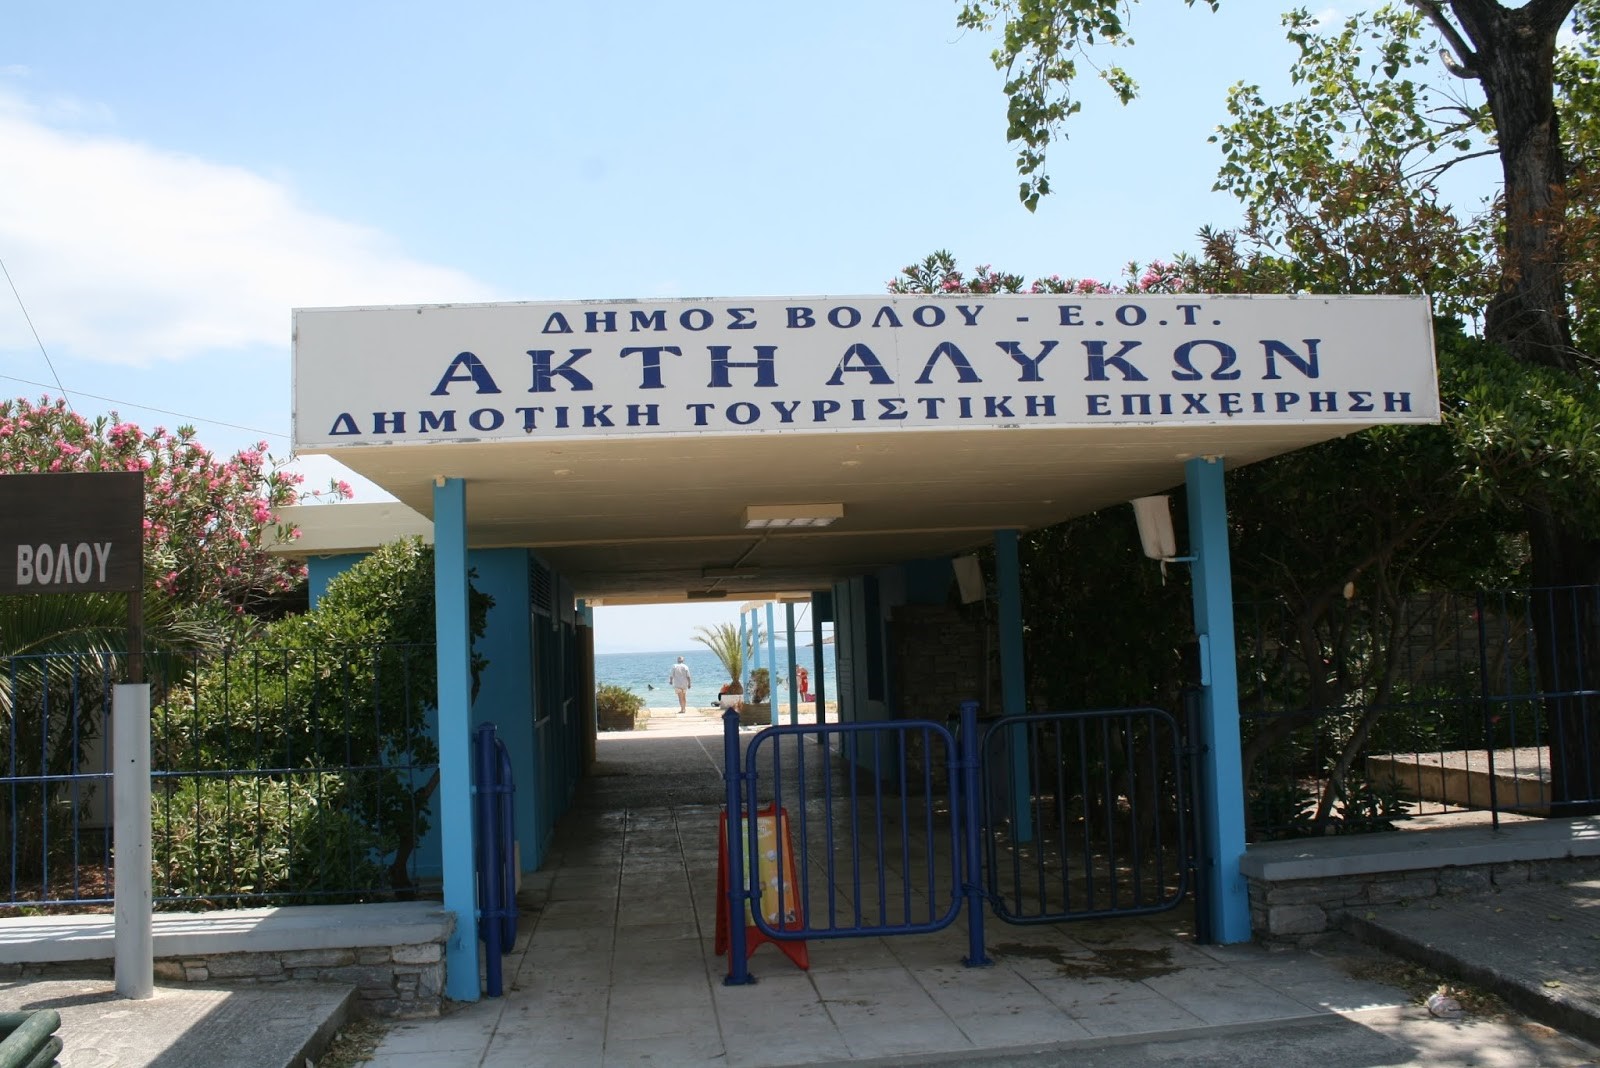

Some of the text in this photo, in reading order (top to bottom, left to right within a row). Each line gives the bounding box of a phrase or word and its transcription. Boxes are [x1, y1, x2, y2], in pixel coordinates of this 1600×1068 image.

[541, 307, 757, 334] ΔΗΜΟΣ
[786, 305, 984, 329] ΒΟΛΟΥ
[1059, 304, 1223, 327] Ε.Ο.Τ.
[430, 338, 1321, 396] ΑΚΤΗ ΑΛΥΚΩΝ
[328, 391, 1412, 435] ΔΗΜΟΤΙΚΗ ΤΟΥΡΙΣΤΙΚΗ ΕΠΙΧΕΙΡΗΣΗ
[16, 542, 112, 585] ΒΟΛΟΥ
